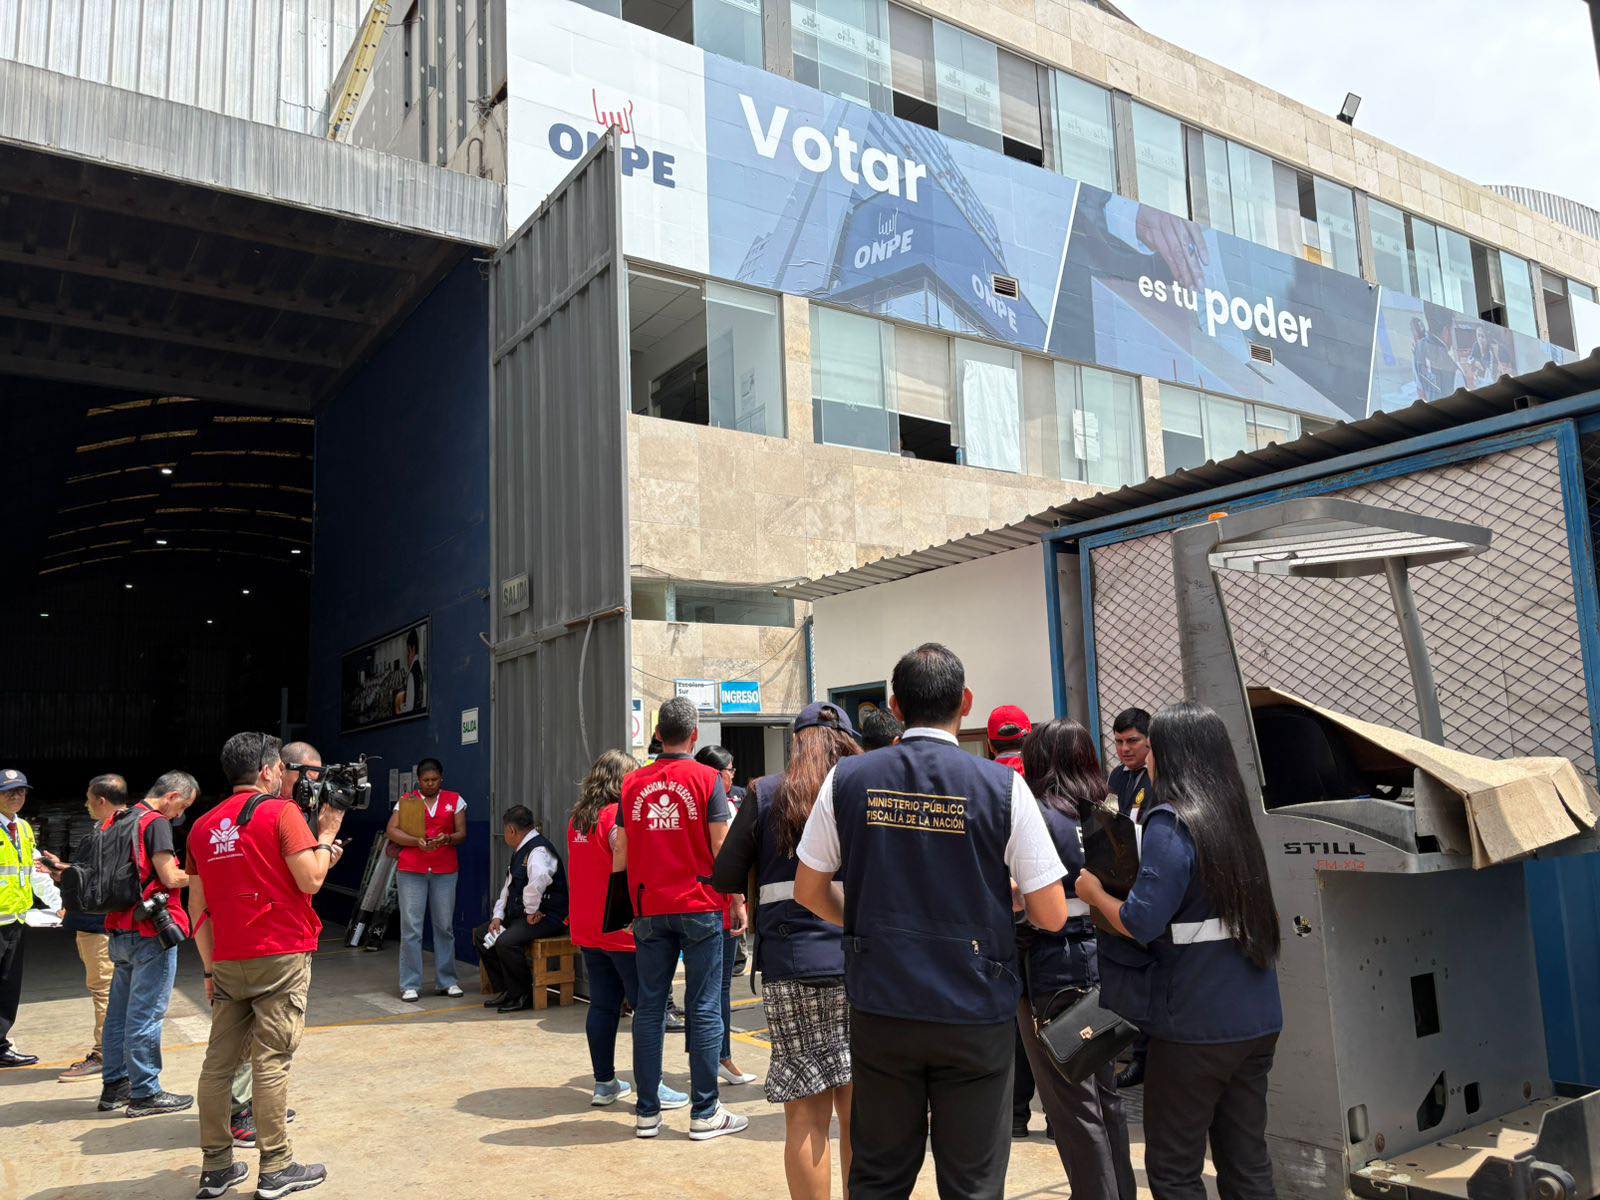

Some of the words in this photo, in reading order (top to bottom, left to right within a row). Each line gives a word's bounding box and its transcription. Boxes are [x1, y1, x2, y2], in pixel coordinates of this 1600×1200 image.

[737, 92, 927, 203] Votar
[854, 229, 914, 269] ONPE
[971, 273, 1018, 333] ONPE
[1138, 275, 1168, 302] es
[1172, 280, 1198, 312] tu
[1204, 287, 1312, 348] poder
[503, 578, 529, 608] SALIDA
[721, 690, 759, 704] INGRESO
[462, 719, 477, 734] SALIDA
[631, 796, 645, 822] JURADO
[668, 780, 678, 792] DE
[675, 783, 699, 821] ELECCIONES
[867, 797, 920, 811] MINISTERIO
[922, 800, 965, 815] PÚBLICO
[648, 818, 680, 829] JNE
[906, 814, 917, 824] DE
[918, 815, 930, 827] LA
[932, 816, 964, 830] NACIÓN
[213, 840, 236, 855] JNE
[1284, 842, 1366, 855] STILL
